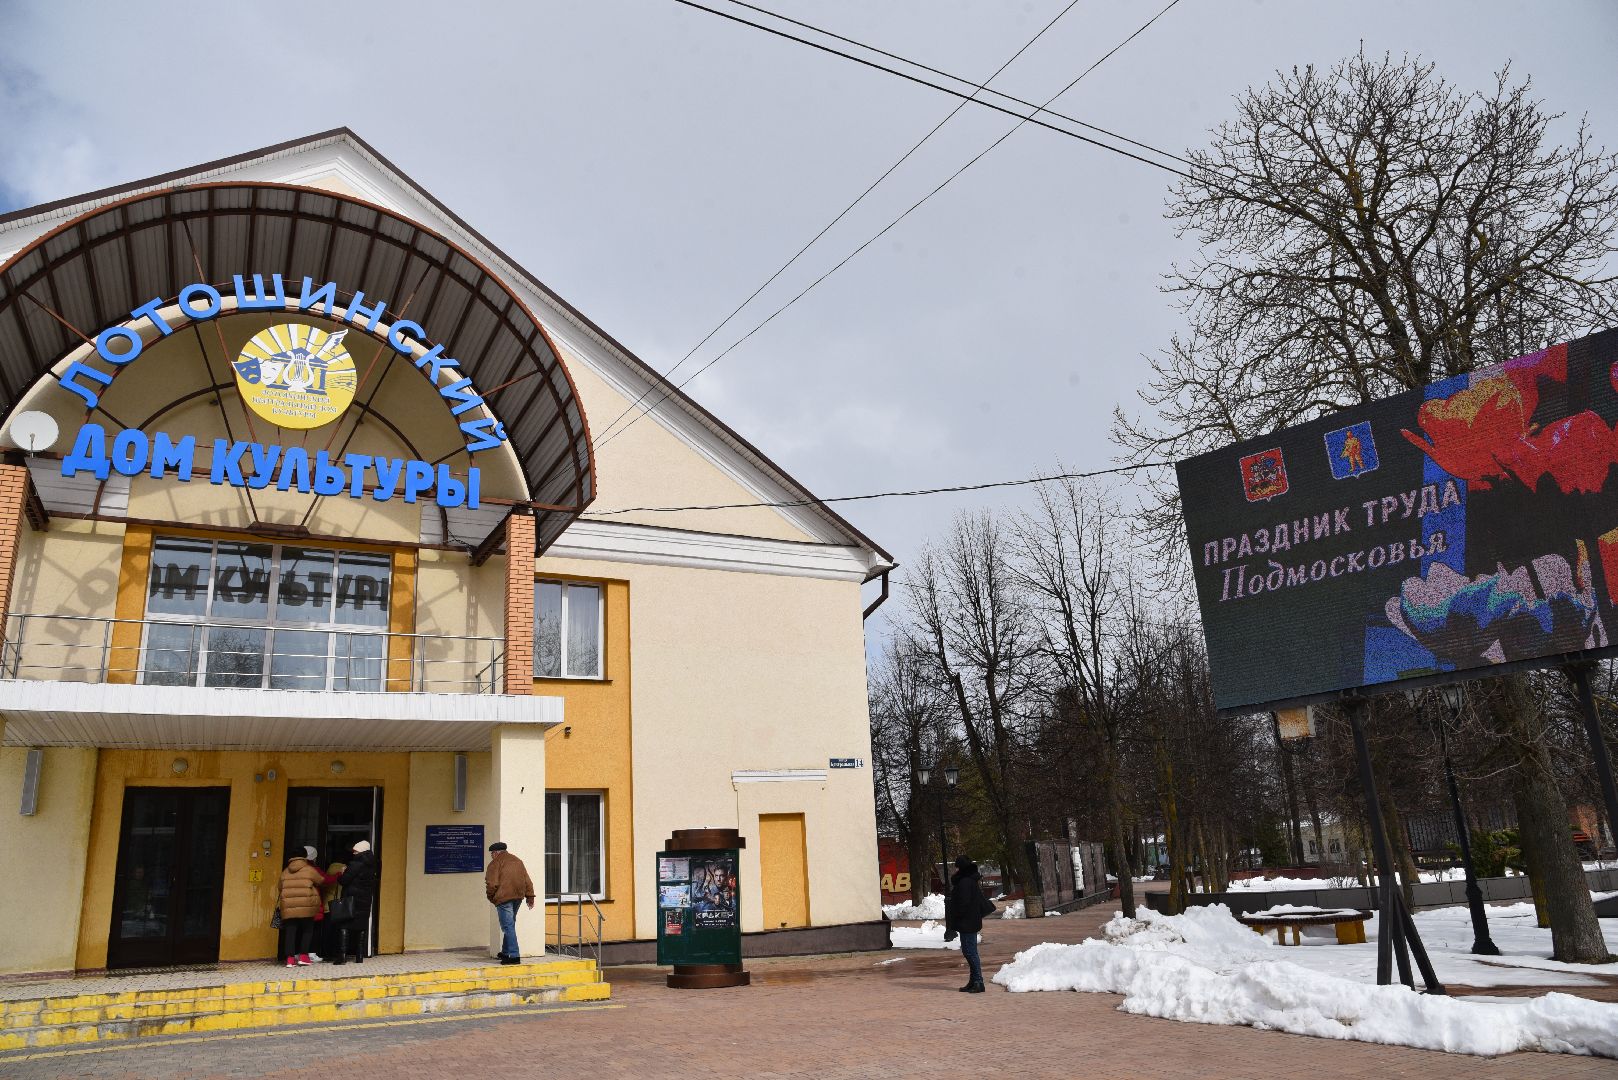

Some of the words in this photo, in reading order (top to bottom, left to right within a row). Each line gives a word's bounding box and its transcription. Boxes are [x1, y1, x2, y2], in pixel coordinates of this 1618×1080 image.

[58, 274, 507, 452] ЛОТОШИНСКИЙ
[61, 423, 195, 482] ДОМ
[210, 438, 480, 509] КУЛЬТУРЫ
[1203, 507, 1351, 566] ПРАЗДНИК
[1362, 480, 1460, 527] ТРУДА
[1218, 531, 1447, 602] Подмосковья
